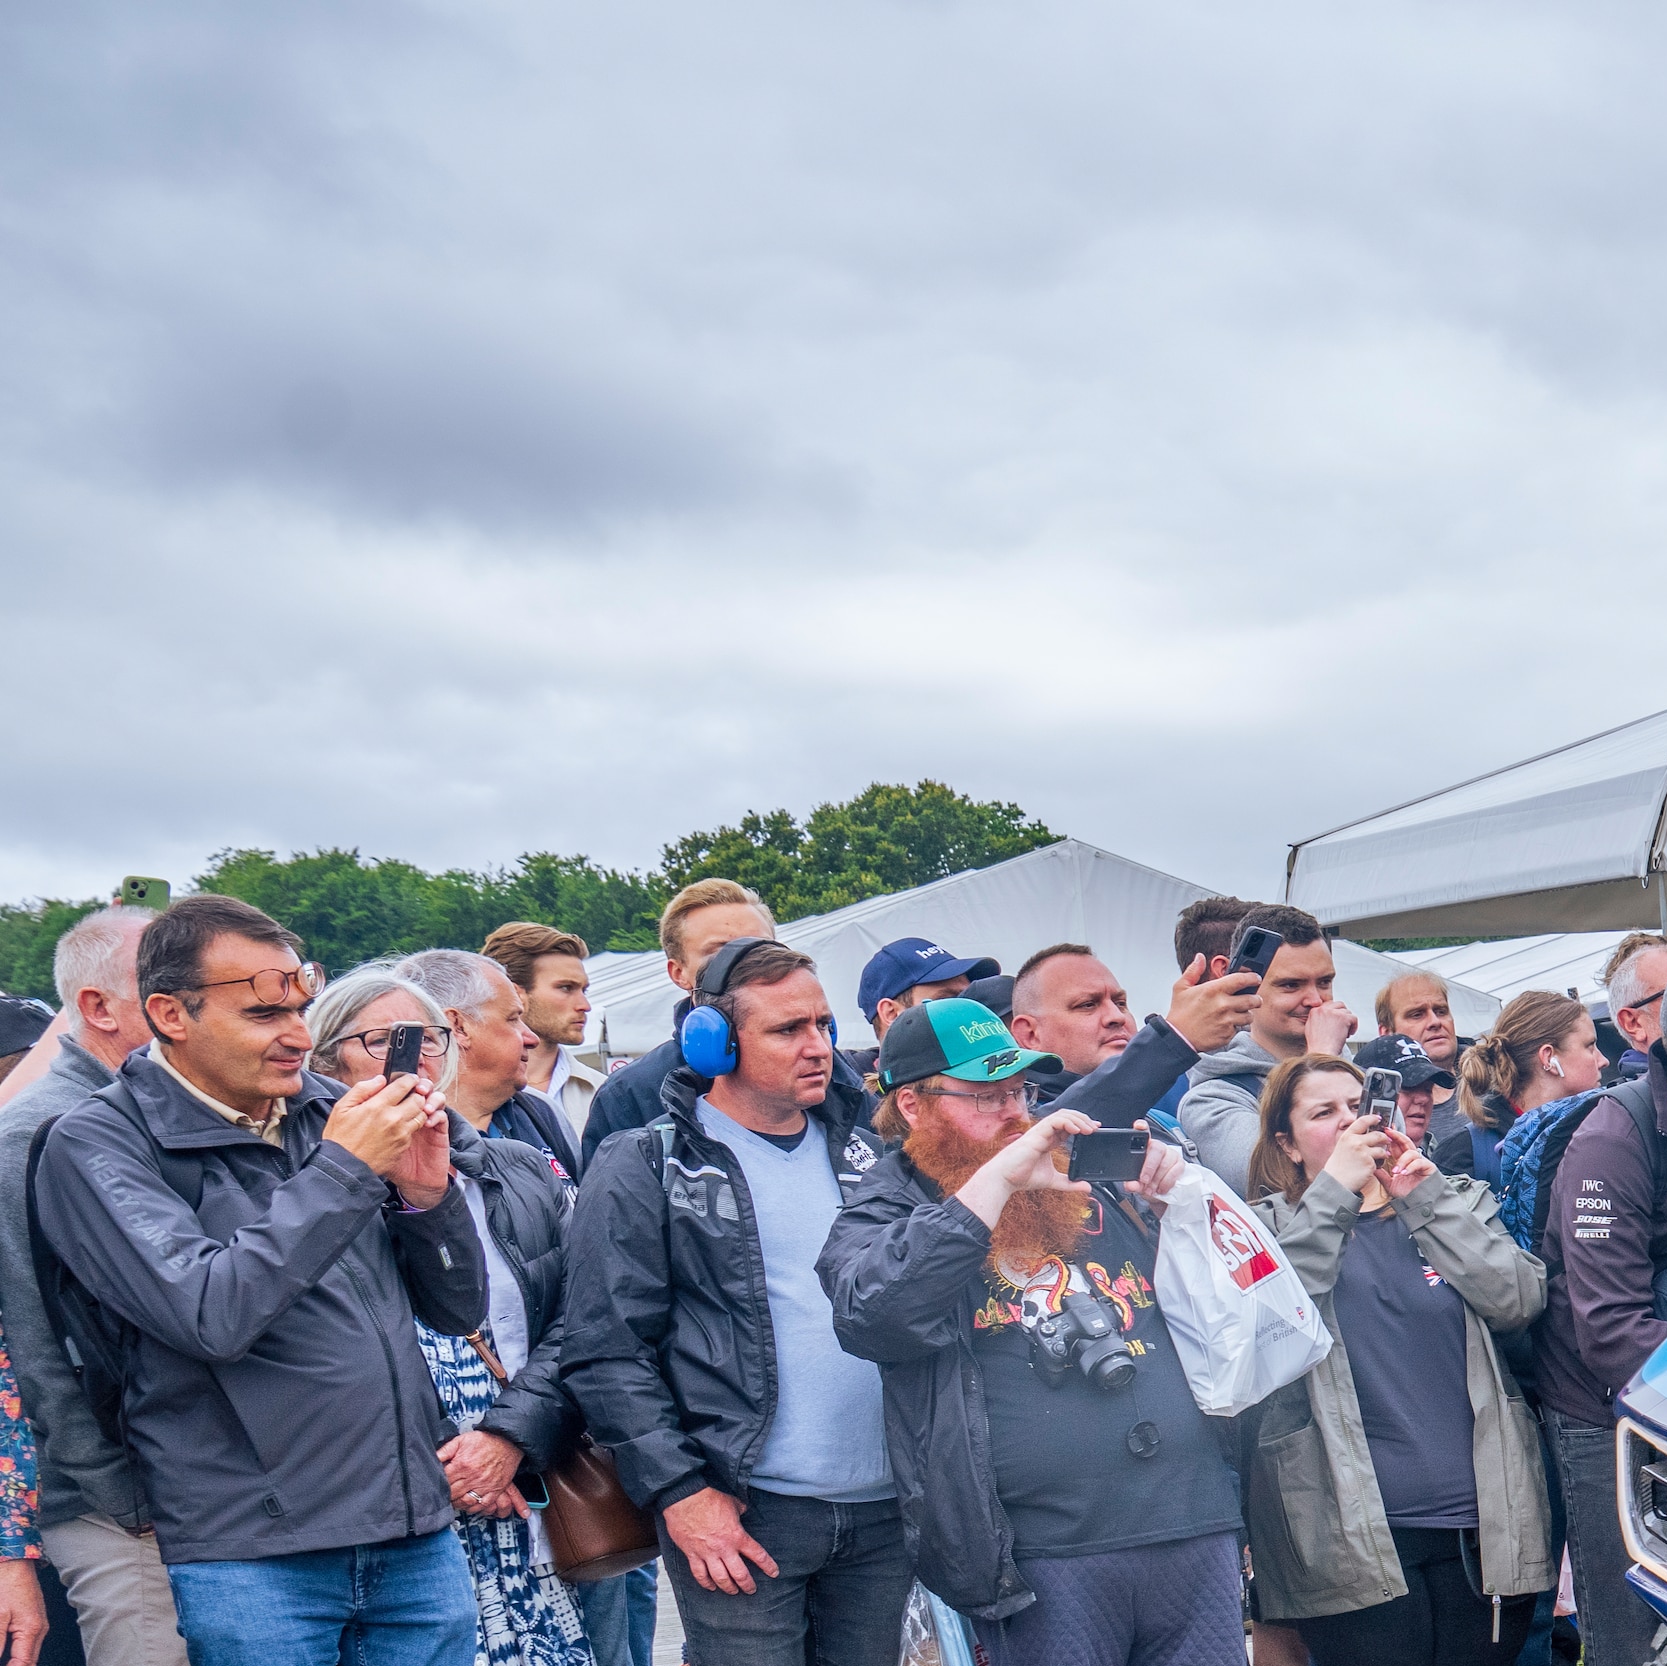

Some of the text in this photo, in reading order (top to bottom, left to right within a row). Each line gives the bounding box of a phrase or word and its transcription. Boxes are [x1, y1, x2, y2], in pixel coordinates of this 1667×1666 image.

[982, 1050, 1022, 1077] 14
[1581, 1179, 1604, 1192] IWC
[1576, 1198, 1612, 1210] EPSON
[1573, 1214, 1618, 1225] BOSE
[1575, 1228, 1611, 1239] PIRELLI
[1272, 1326, 1298, 1343] British
